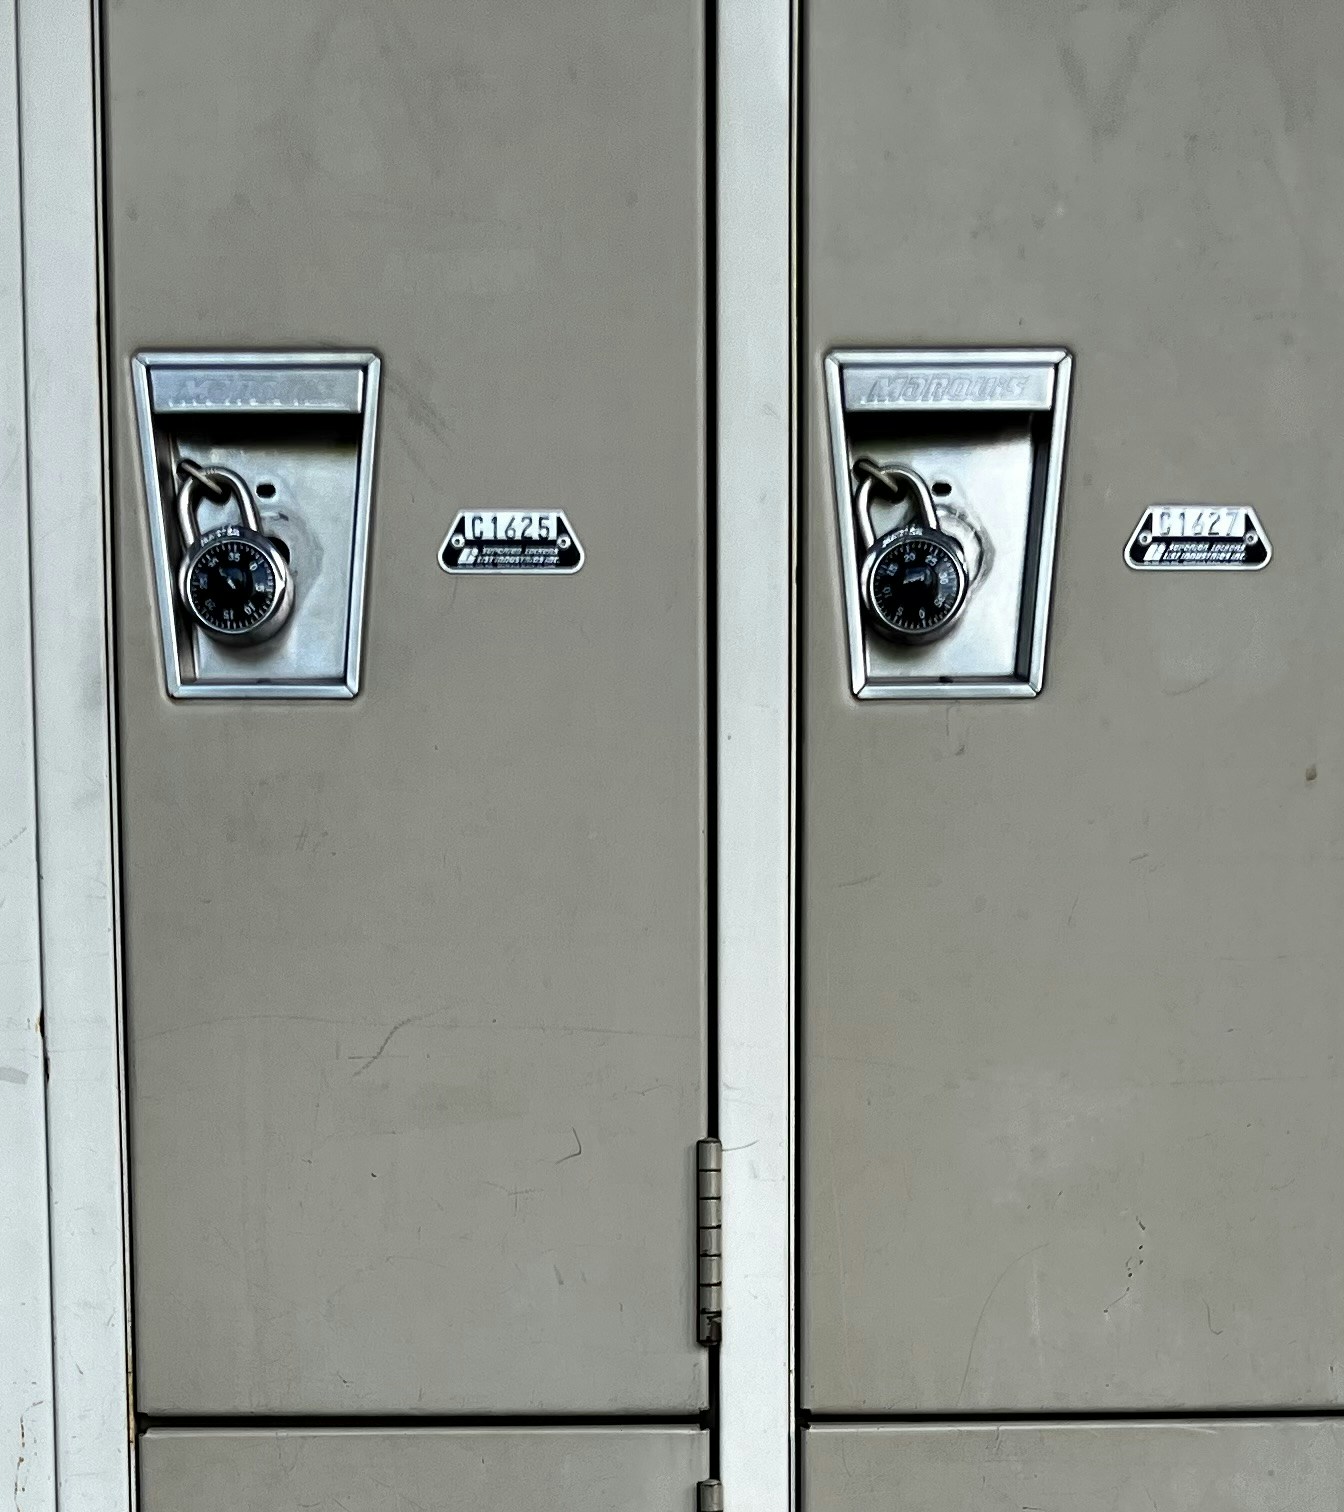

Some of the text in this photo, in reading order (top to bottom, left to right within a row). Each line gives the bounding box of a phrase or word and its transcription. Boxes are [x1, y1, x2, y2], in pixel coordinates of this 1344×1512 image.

[472, 516, 549, 540] C1625
[1160, 512, 1238, 536] C1627
[224, 610, 233, 619] 15
[244, 602, 256, 614] 10
